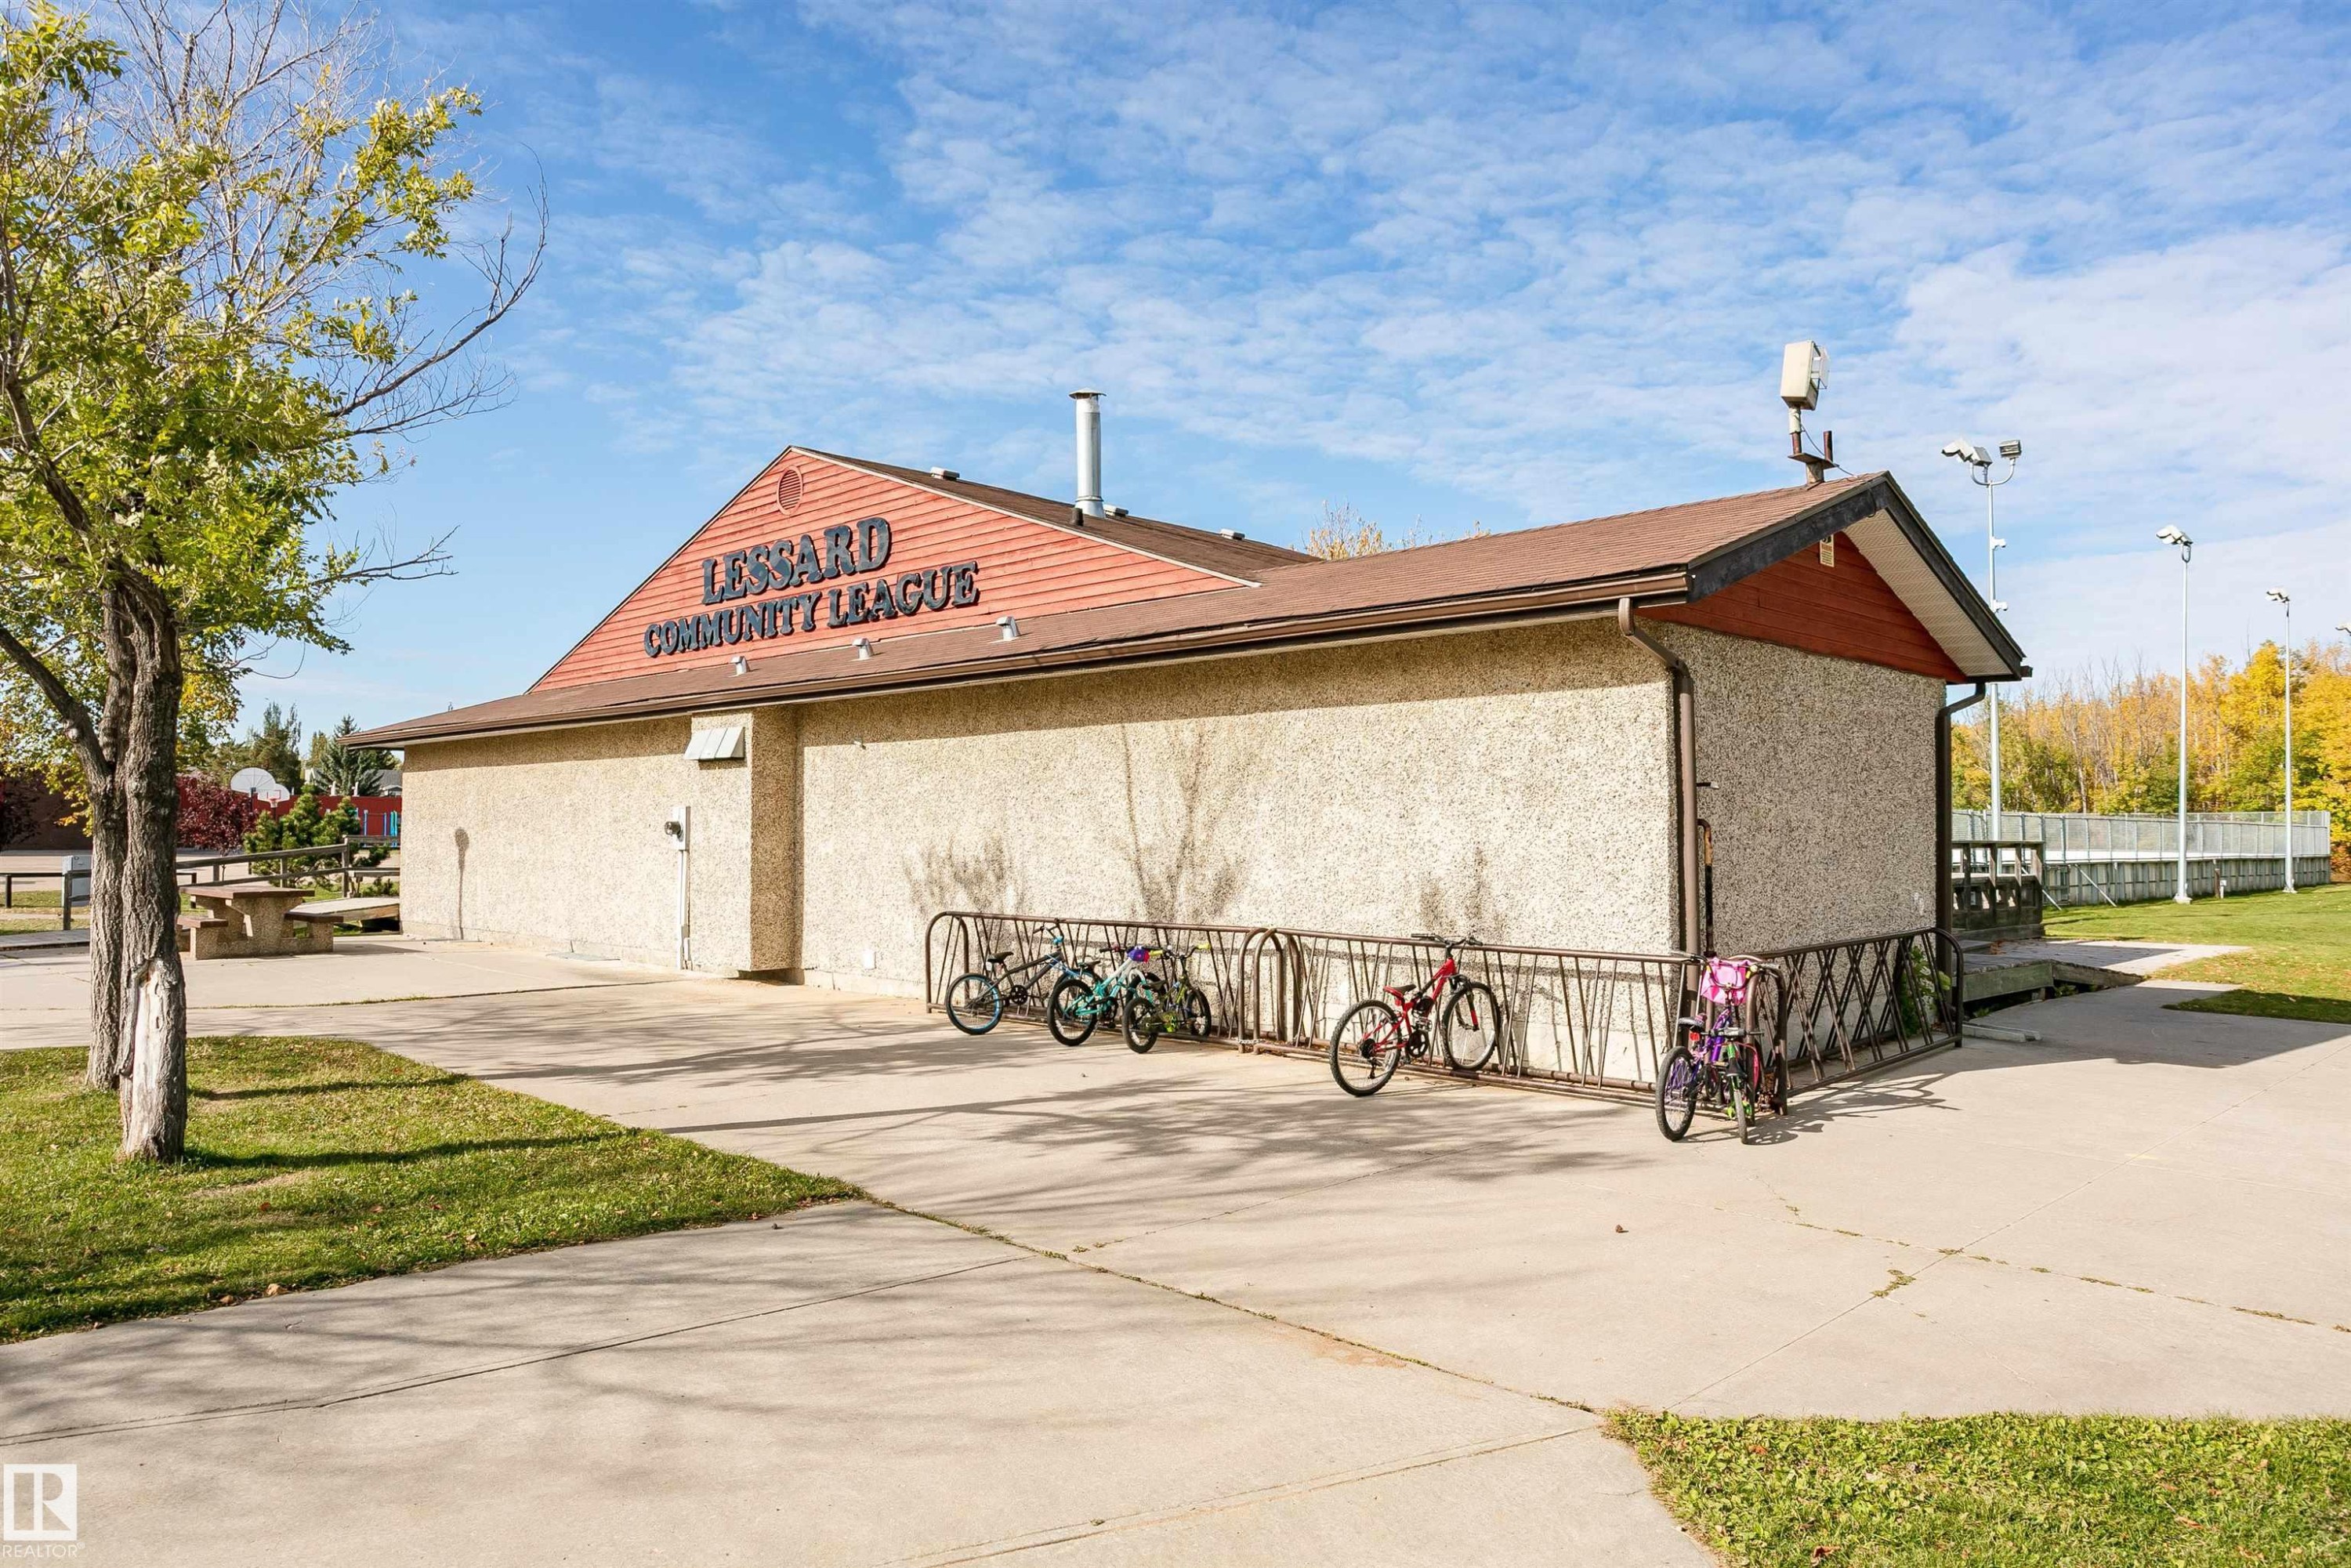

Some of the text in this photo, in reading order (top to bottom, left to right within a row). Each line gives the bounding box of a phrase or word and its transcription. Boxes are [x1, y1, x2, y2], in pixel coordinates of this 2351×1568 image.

[701, 517, 892, 605] LESSARD
[644, 561, 979, 657] COMMUNITY LEAGUE
